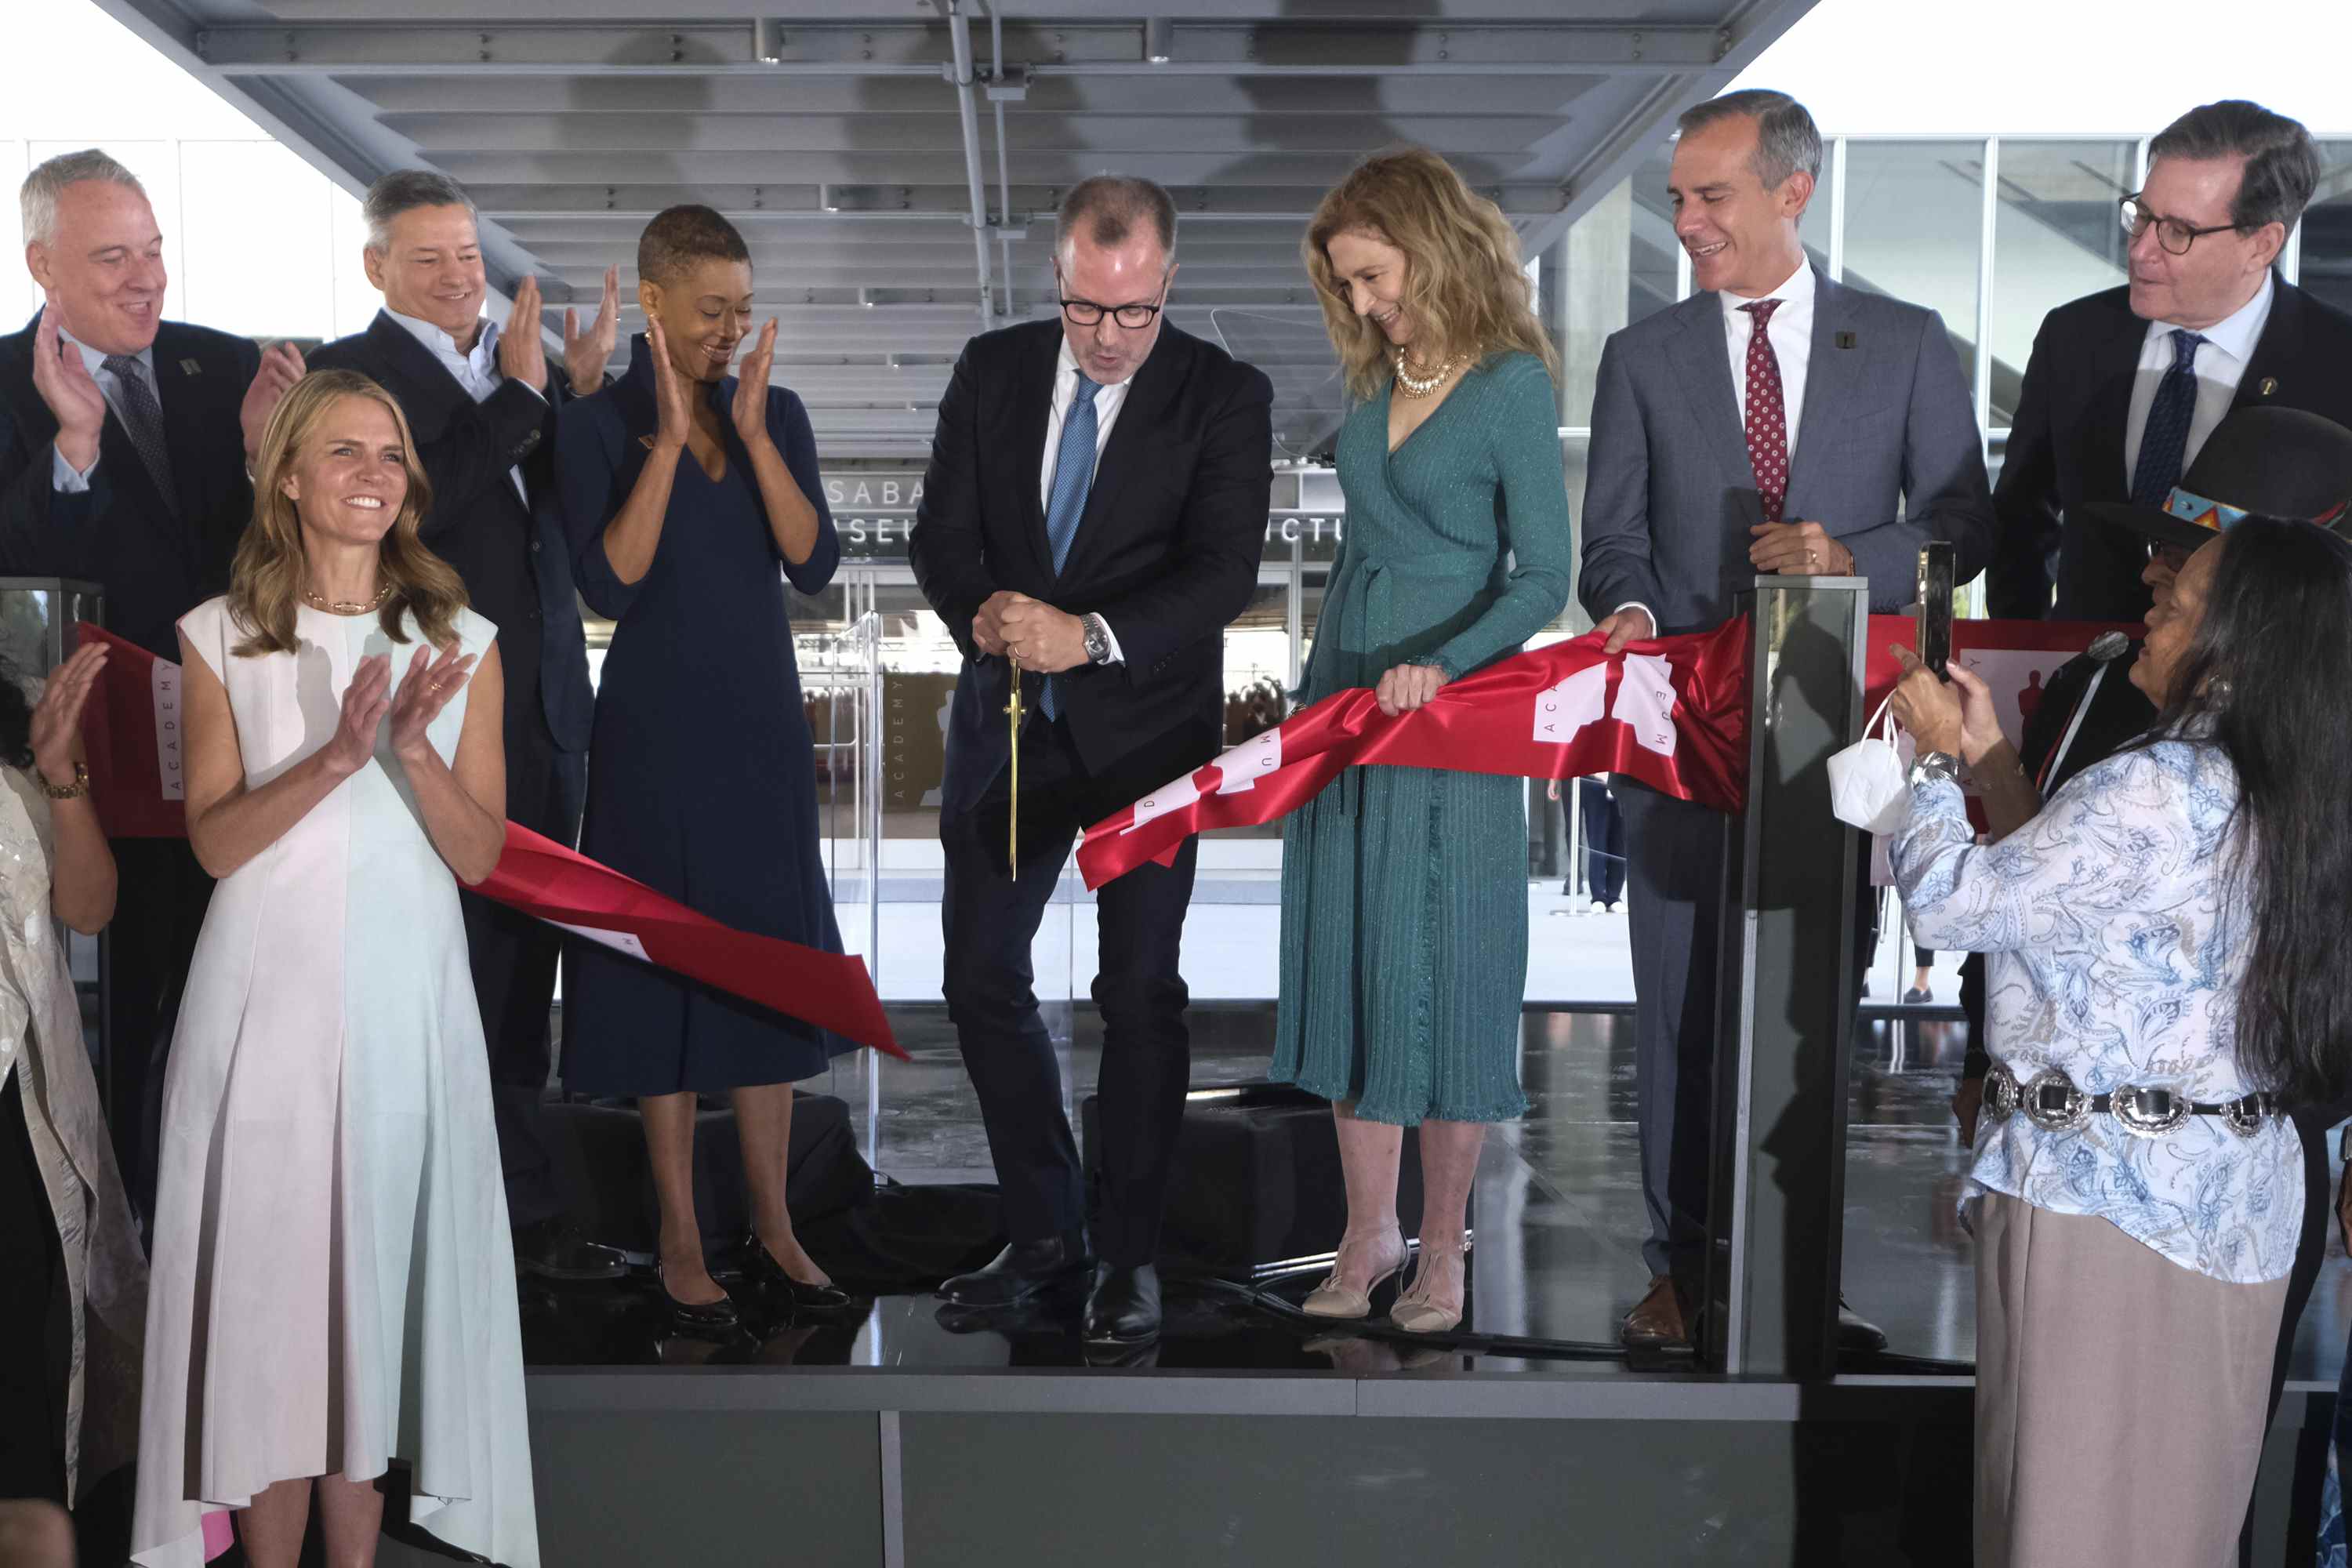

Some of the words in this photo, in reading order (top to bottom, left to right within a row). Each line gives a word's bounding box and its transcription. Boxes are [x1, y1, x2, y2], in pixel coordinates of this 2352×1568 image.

[827, 480, 924, 504] SABA
[161, 663, 181, 790] ACADEMY
[891, 681, 904, 798] ACADEMY
